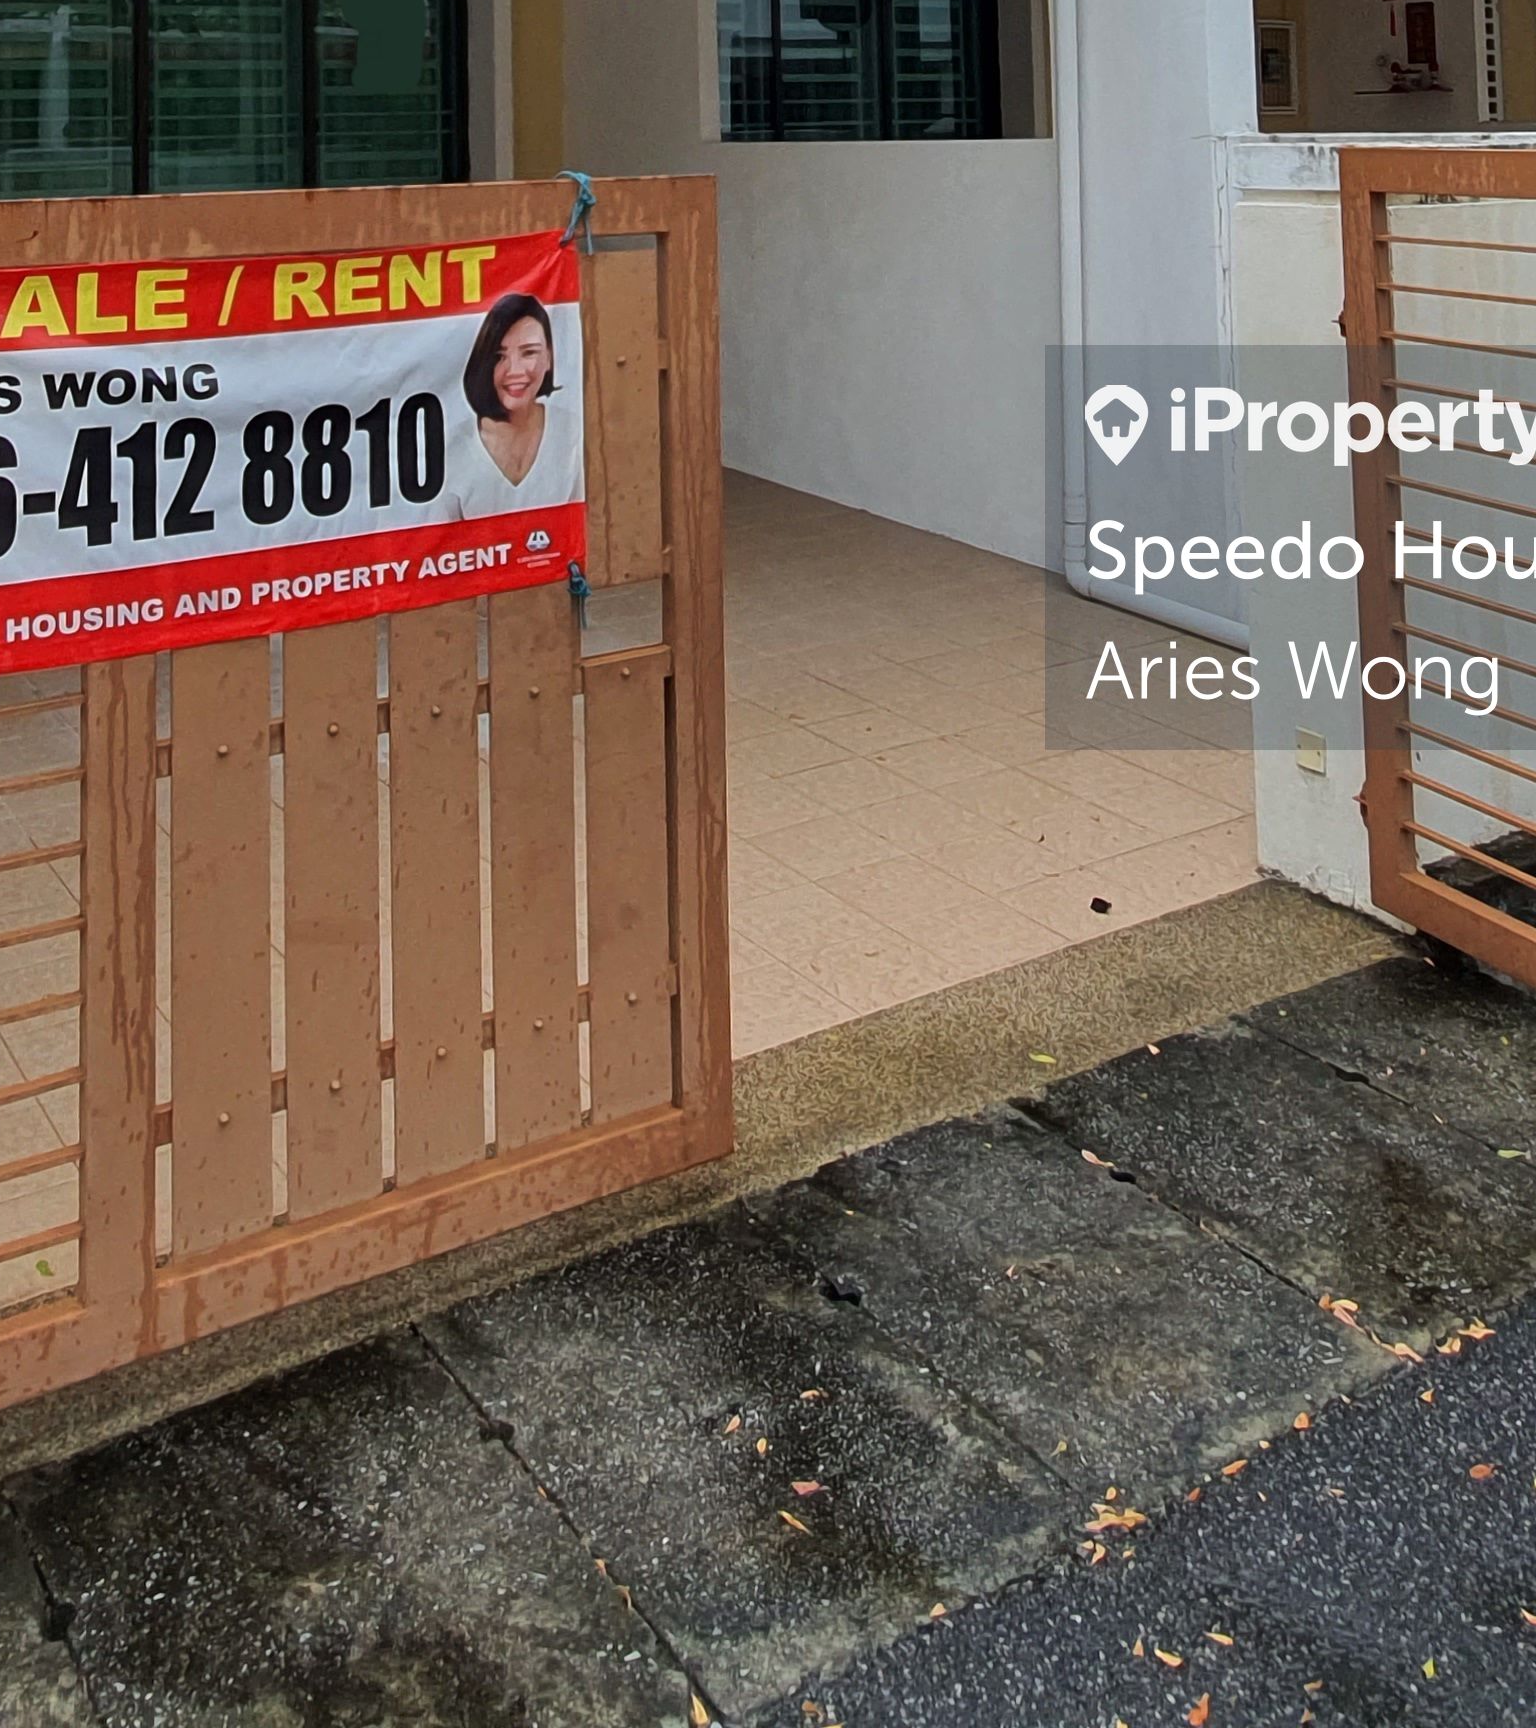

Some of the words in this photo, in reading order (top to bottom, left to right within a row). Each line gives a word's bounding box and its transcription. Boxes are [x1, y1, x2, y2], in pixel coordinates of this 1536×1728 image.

[218, 265, 244, 326] /
[273, 245, 496, 321] RENT
[43, 363, 219, 410] WONG
[242, 392, 445, 525] 8810
[6, 597, 163, 643] HOUSING
[174, 586, 241, 618] AND
[251, 559, 410, 606] PROPERTY
[418, 543, 512, 580] AGENT
